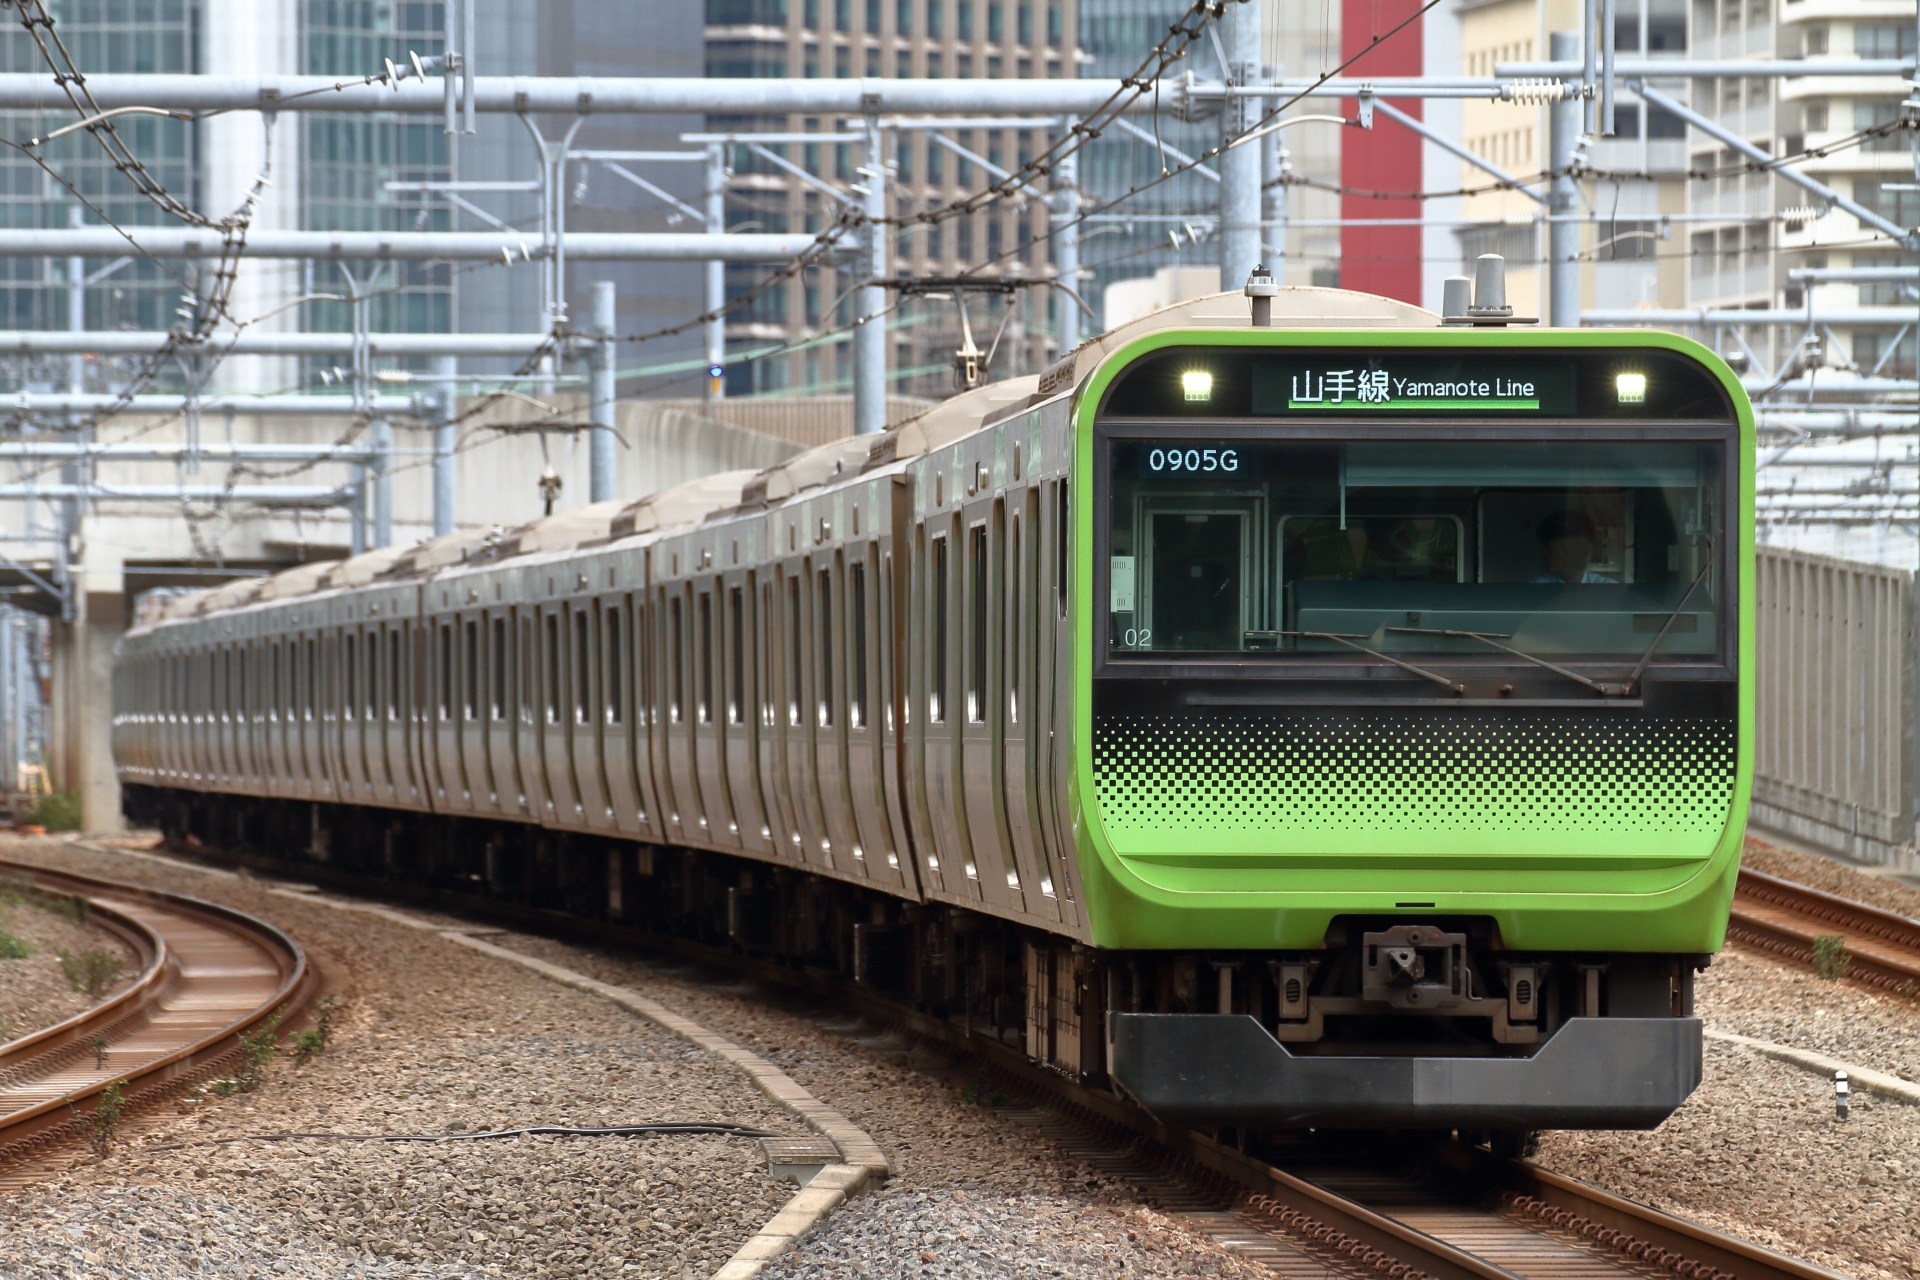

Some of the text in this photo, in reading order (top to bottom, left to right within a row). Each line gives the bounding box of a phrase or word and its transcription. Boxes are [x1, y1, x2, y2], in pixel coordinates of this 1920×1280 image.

[1292, 369, 1391, 403] 山手線
[1392, 377, 1535, 397] Yamanote Line
[1149, 448, 1239, 472] 0905G
[1125, 628, 1151, 647] 02
